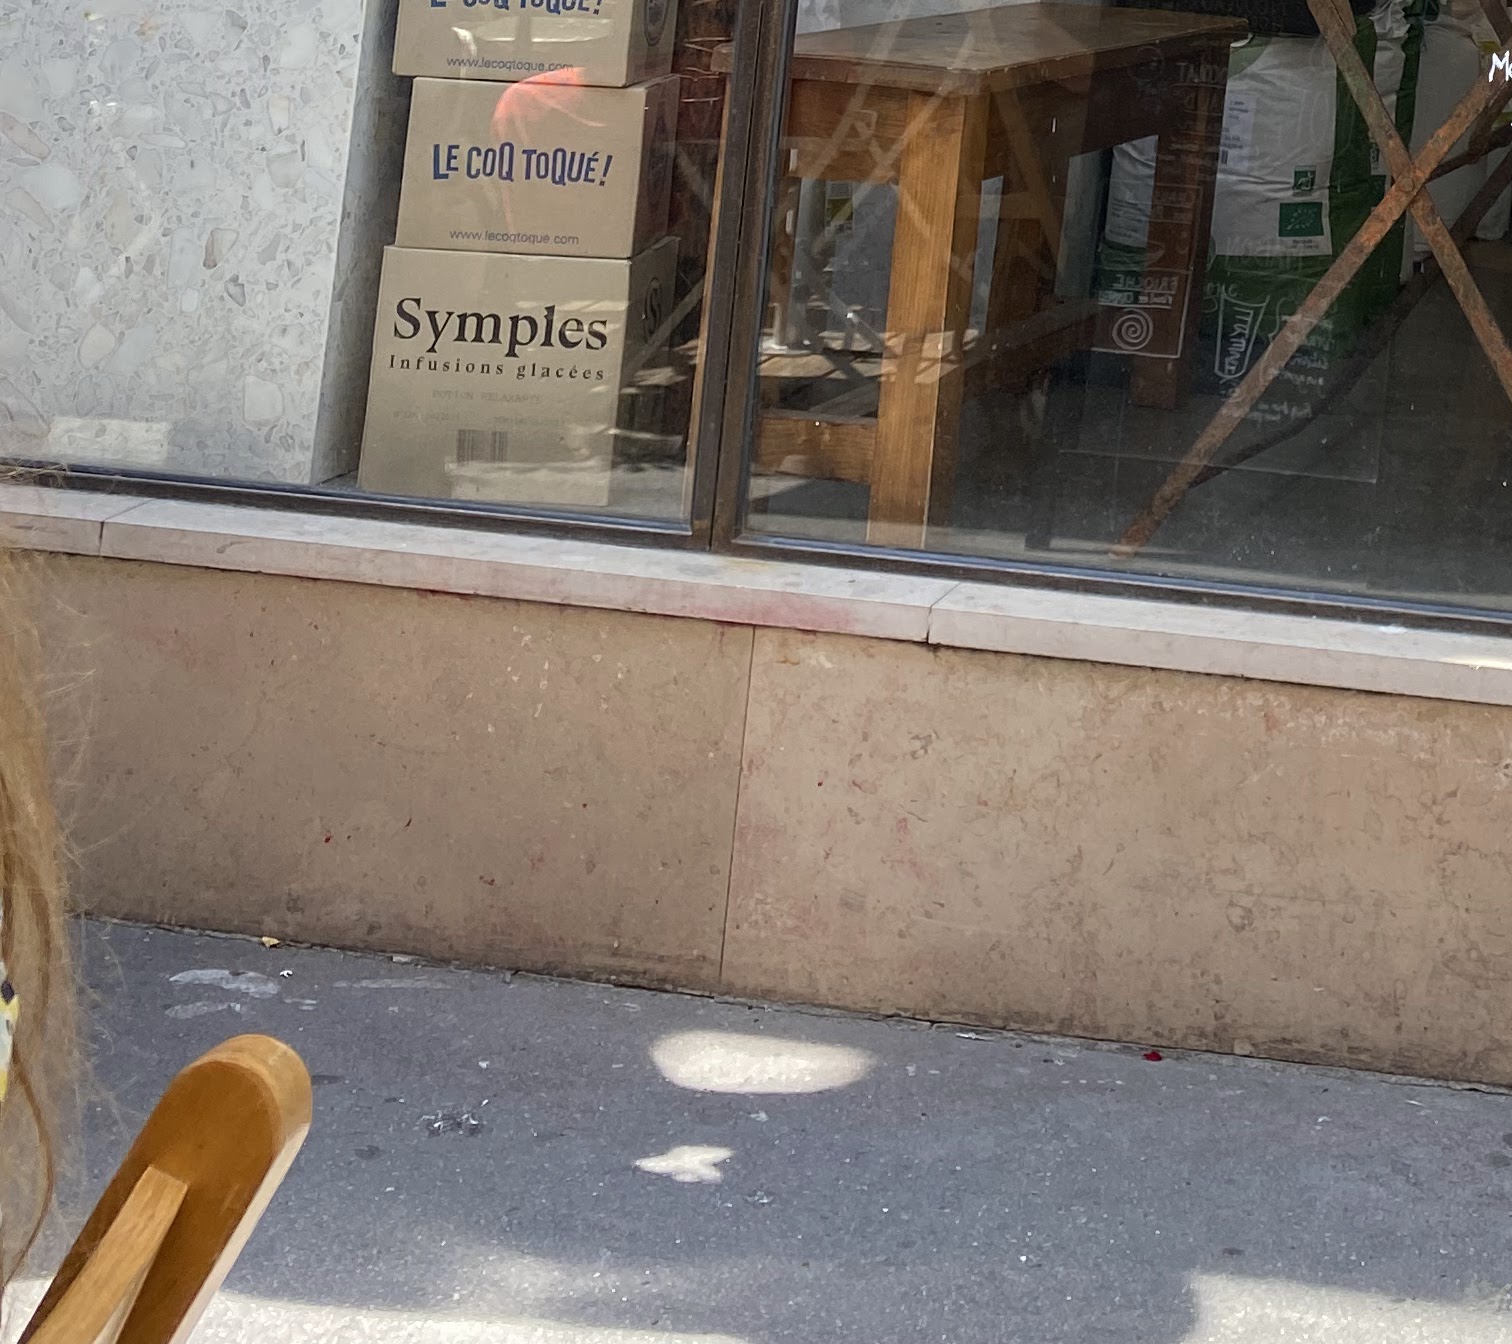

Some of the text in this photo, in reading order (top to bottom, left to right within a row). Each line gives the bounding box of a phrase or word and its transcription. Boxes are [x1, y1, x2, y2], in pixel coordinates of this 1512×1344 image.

[433, 142, 460, 182] LE
[465, 142, 515, 183] COQ
[448, 227, 580, 248] www.lecoqtoque.com
[392, 295, 608, 358] Symples
[389, 353, 605, 381] Infusions glacées
